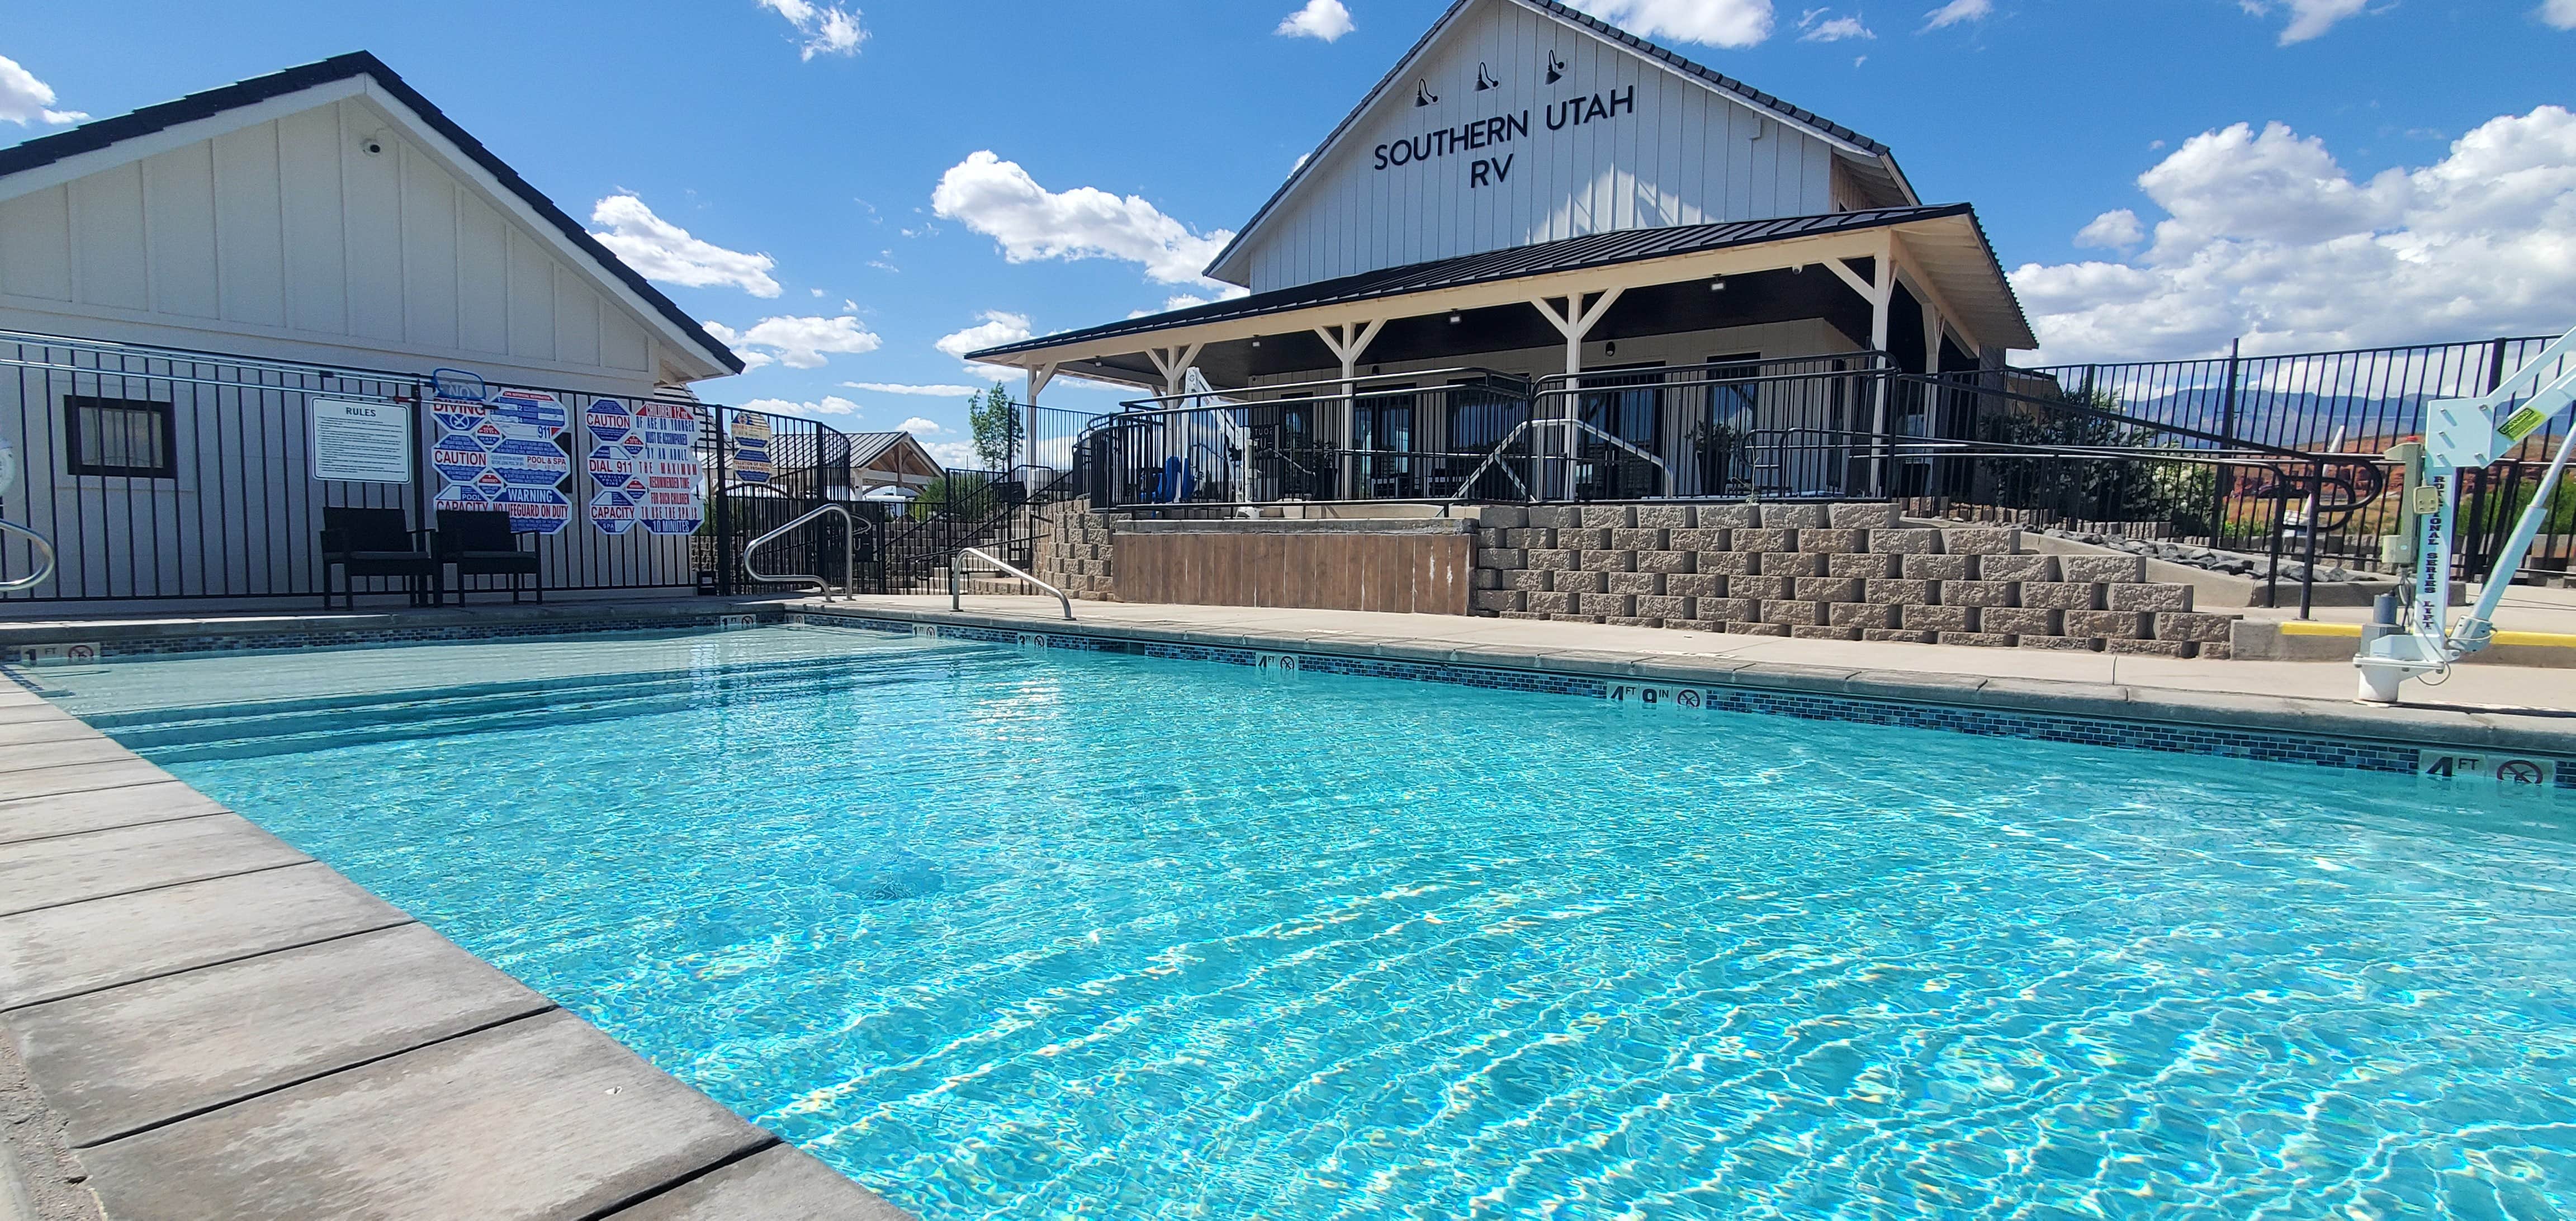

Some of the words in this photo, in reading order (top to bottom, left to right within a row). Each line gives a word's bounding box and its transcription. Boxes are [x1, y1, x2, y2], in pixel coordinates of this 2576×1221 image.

[1374, 110, 1528, 171] SOUTHERN
[1546, 85, 1634, 130] UTAH
[1470, 153, 1513, 188] RV
[448, 384, 470, 398] NO
[345, 407, 376, 417] RULES
[434, 398, 486, 415] DIVING
[646, 404, 671, 418] CHILDREN
[674, 407, 680, 418] 12
[587, 414, 630, 428] CAUTION
[636, 417, 642, 428] OF
[647, 417, 657, 429] AGE
[660, 418, 667, 430] OR
[671, 419, 695, 432] YOUNGER
[538, 425, 551, 439] 911
[645, 432, 656, 444] MUST
[657, 432, 662, 444] BE
[663, 432, 688, 445] ACCOMPANIED
[434, 451, 486, 465] CAUTION
[659, 448, 666, 460] AN
[589, 460, 613, 472] DIAL
[617, 461, 632, 473] 911
[639, 461, 653, 474] THE
[661, 462, 697, 475] MAXIMUM
[649, 476, 679, 489] RECOMMENDED
[680, 477, 690, 489] TIME
[508, 488, 553, 503] WARNING
[660, 493, 670, 505] SUCH
[671, 493, 690, 505] CHILDREN
[437, 500, 489, 512] CAPACITY
[493, 503, 503, 512] NO
[542, 505, 551, 517] ON
[552, 505, 569, 518] DUTY
[591, 507, 634, 519] CAPACITY
[642, 507, 648, 518] TO
[652, 507, 662, 519] USE
[665, 507, 675, 519] THE
[679, 507, 688, 519] SPA
[692, 507, 698, 519] IS
[2428, 476, 2445, 545] ROTIONAL
[653, 520, 661, 532] 10
[662, 520, 689, 532] MINUTES
[2425, 552, 2438, 593] SERIES
[2422, 601, 2435, 627] LIFT
[913, 626, 917, 636] 1
[25, 649, 36, 660] 1
[1258, 655, 1267, 667] 4
[1610, 685, 1623, 701] 4
[1659, 689, 1669, 698] IN
[2426, 756, 2453, 777] 4
[2458, 758, 2479, 770] FT
